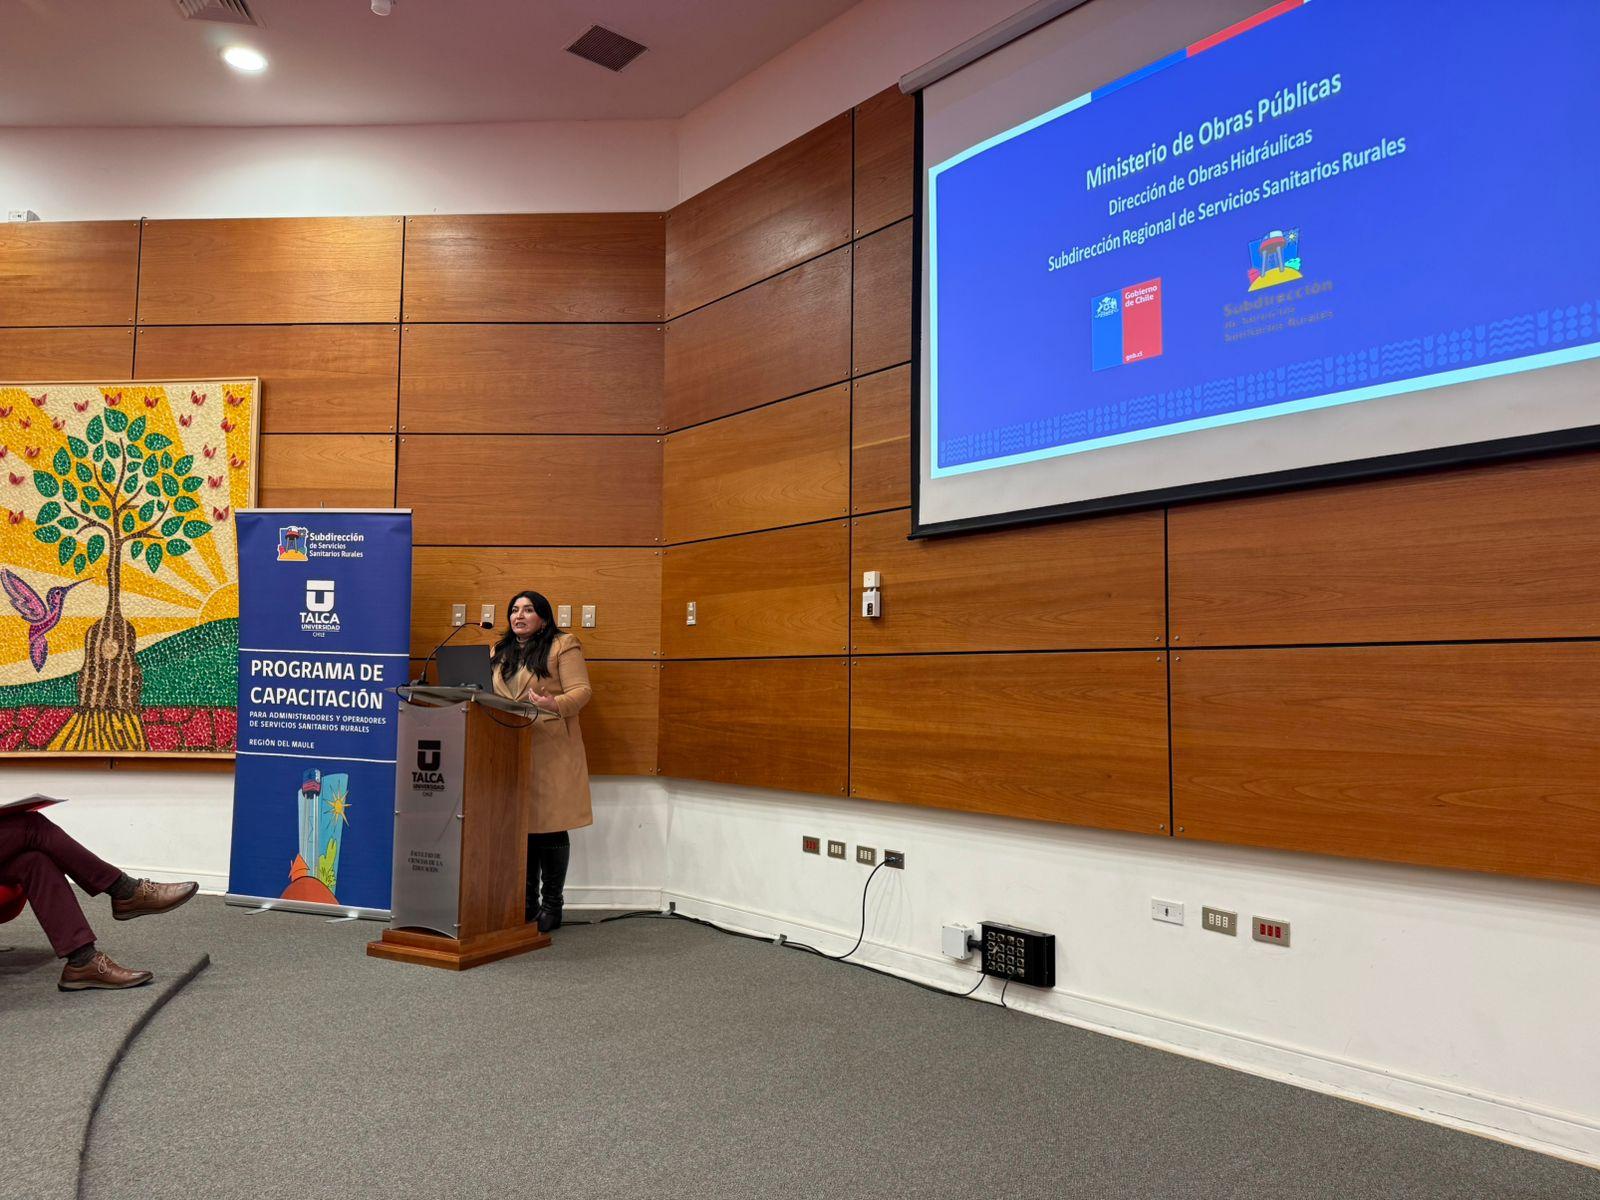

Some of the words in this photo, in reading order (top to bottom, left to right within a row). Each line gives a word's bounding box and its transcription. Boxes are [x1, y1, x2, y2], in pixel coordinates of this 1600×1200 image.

[1086, 143, 1167, 190] Ministerio
[1172, 131, 1194, 156] de
[1199, 109, 1253, 145] Obras
[1258, 73, 1342, 122] Públicas
[1109, 184, 1166, 215] Dirección
[1169, 175, 1185, 194] de
[1188, 160, 1229, 186] Obras
[1231, 129, 1313, 171] Hidráulicas
[1048, 234, 1121, 271] Subdirección
[1123, 212, 1176, 246] Regional
[1178, 208, 1195, 227] de
[1198, 187, 1260, 220] Servicios
[1262, 160, 1340, 198] Sanitarios
[1342, 137, 1406, 172] Rurales
[1125, 285, 1158, 300] Gobierno
[1125, 300, 1134, 308] de
[1135, 294, 1154, 304] Chile
[310, 532, 364, 542] Subdirección
[318, 542, 347, 550] Servicios
[341, 550, 363, 558] Rurales
[300, 612, 340, 624] TALCA
[251, 660, 355, 680] PROGRAMA
[360, 664, 384, 682] DE
[250, 687, 383, 709] CAPACITACIÓN
[269, 712, 334, 721] ADMINISTRADORES
[342, 716, 386, 724] OPERADORES
[260, 721, 296, 729] SERVICIOS
[298, 723, 338, 732] SANITARIOS
[340, 725, 369, 733] RURALES
[249, 738, 275, 746] REGIÓN
[292, 741, 315, 749] MAULE
[411, 771, 445, 784] TALCA
